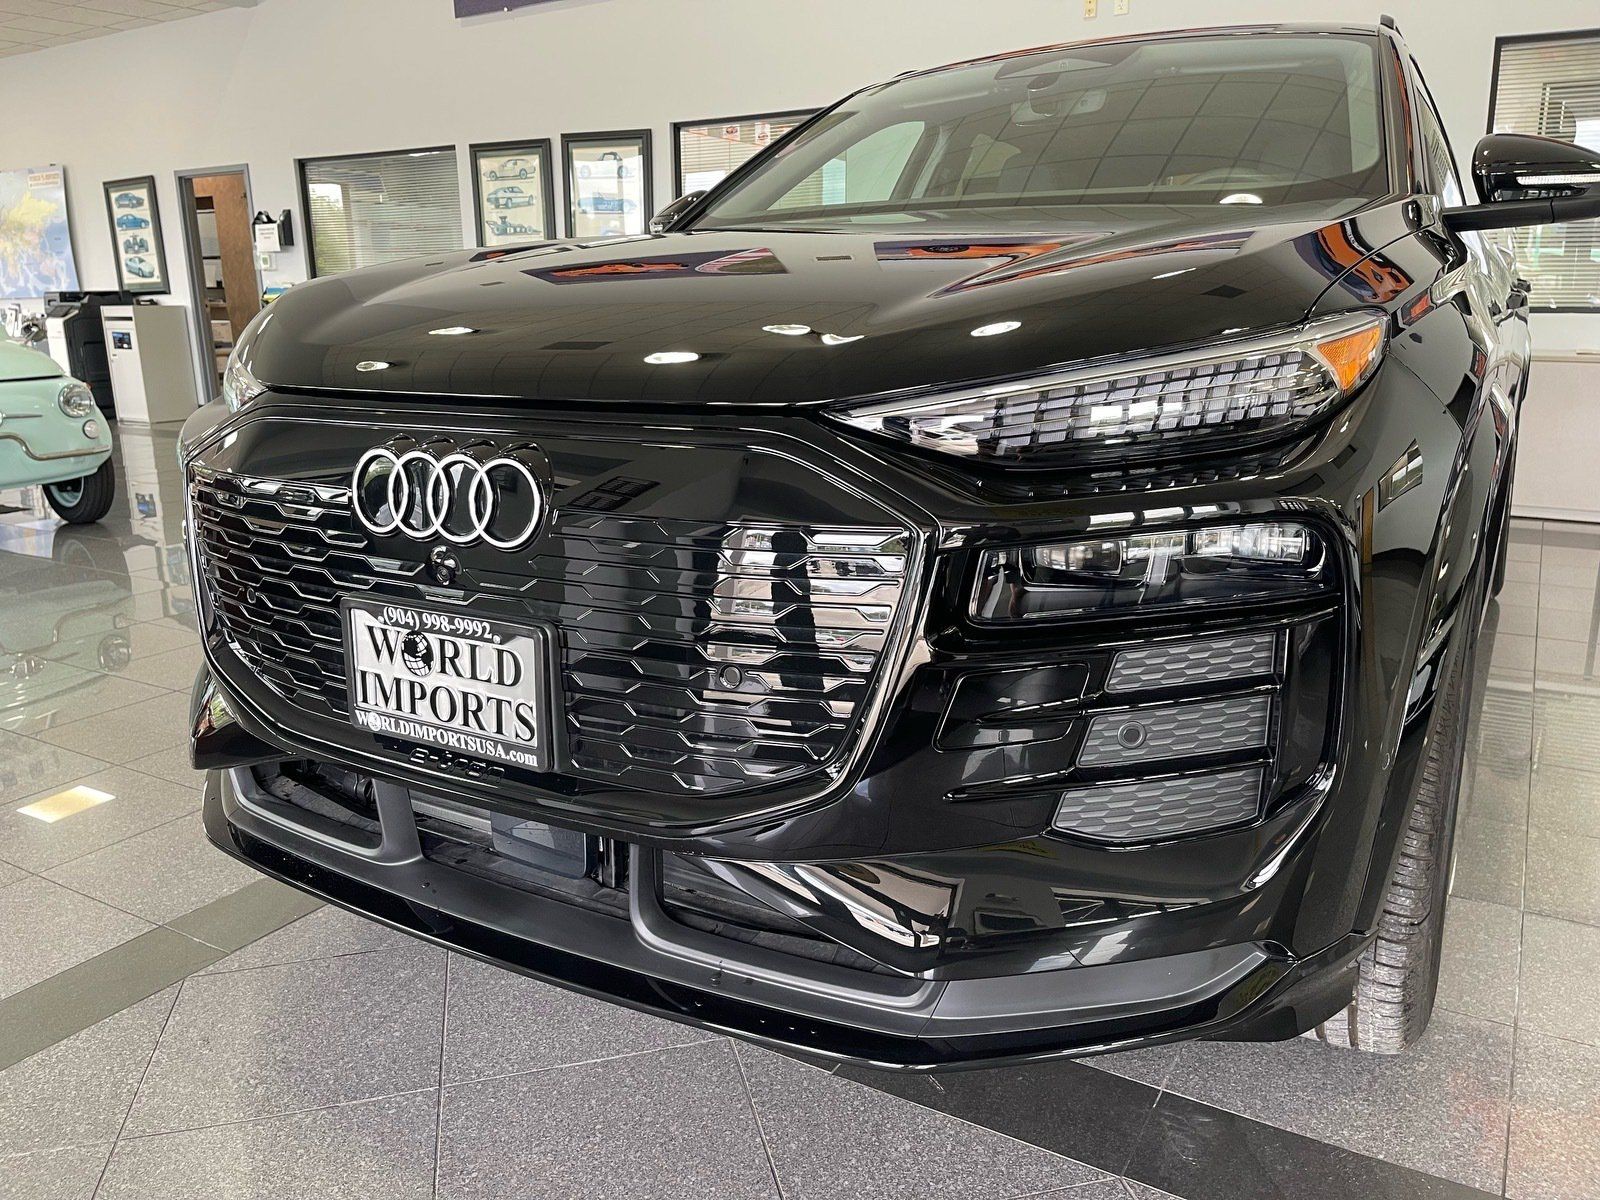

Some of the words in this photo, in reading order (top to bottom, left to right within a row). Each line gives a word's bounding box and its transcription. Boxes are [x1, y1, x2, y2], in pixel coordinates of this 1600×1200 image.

[383, 606, 419, 631] (904)
[422, 612, 493, 640] 998-9992
[365, 624, 522, 687] WORLD
[359, 670, 535, 742] IMPORTS
[354, 710, 538, 767] WORLDIMPORTSUSA.com
